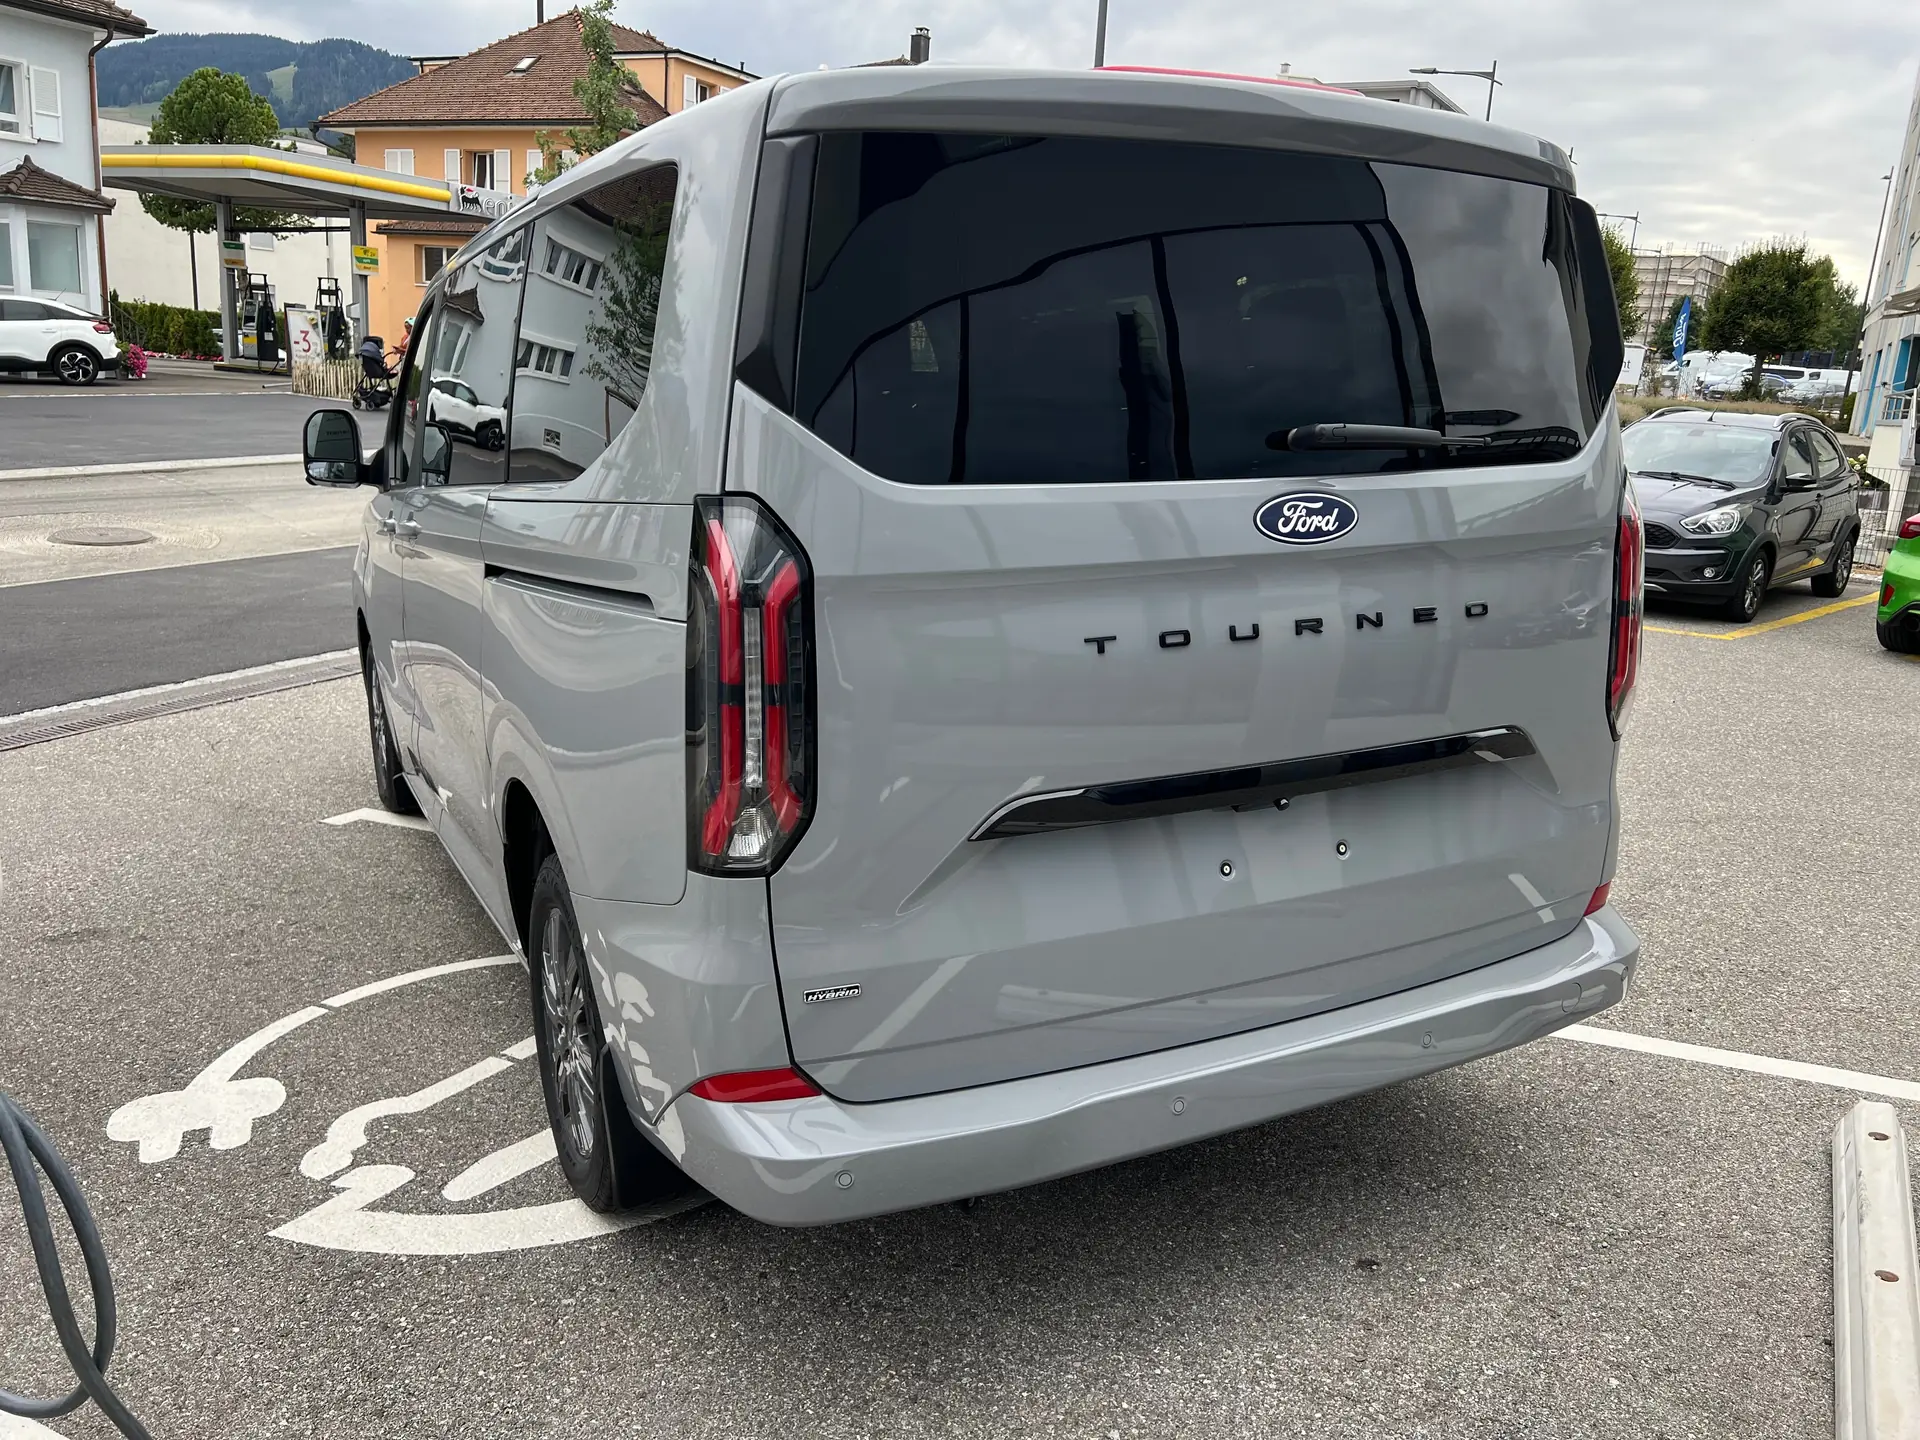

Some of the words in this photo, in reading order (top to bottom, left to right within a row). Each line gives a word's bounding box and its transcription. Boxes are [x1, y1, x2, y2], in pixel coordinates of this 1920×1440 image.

[1277, 500, 1339, 534] Ford
[1084, 601, 1489, 655] TOURNEO
[807, 988, 859, 1001] HYBRID
